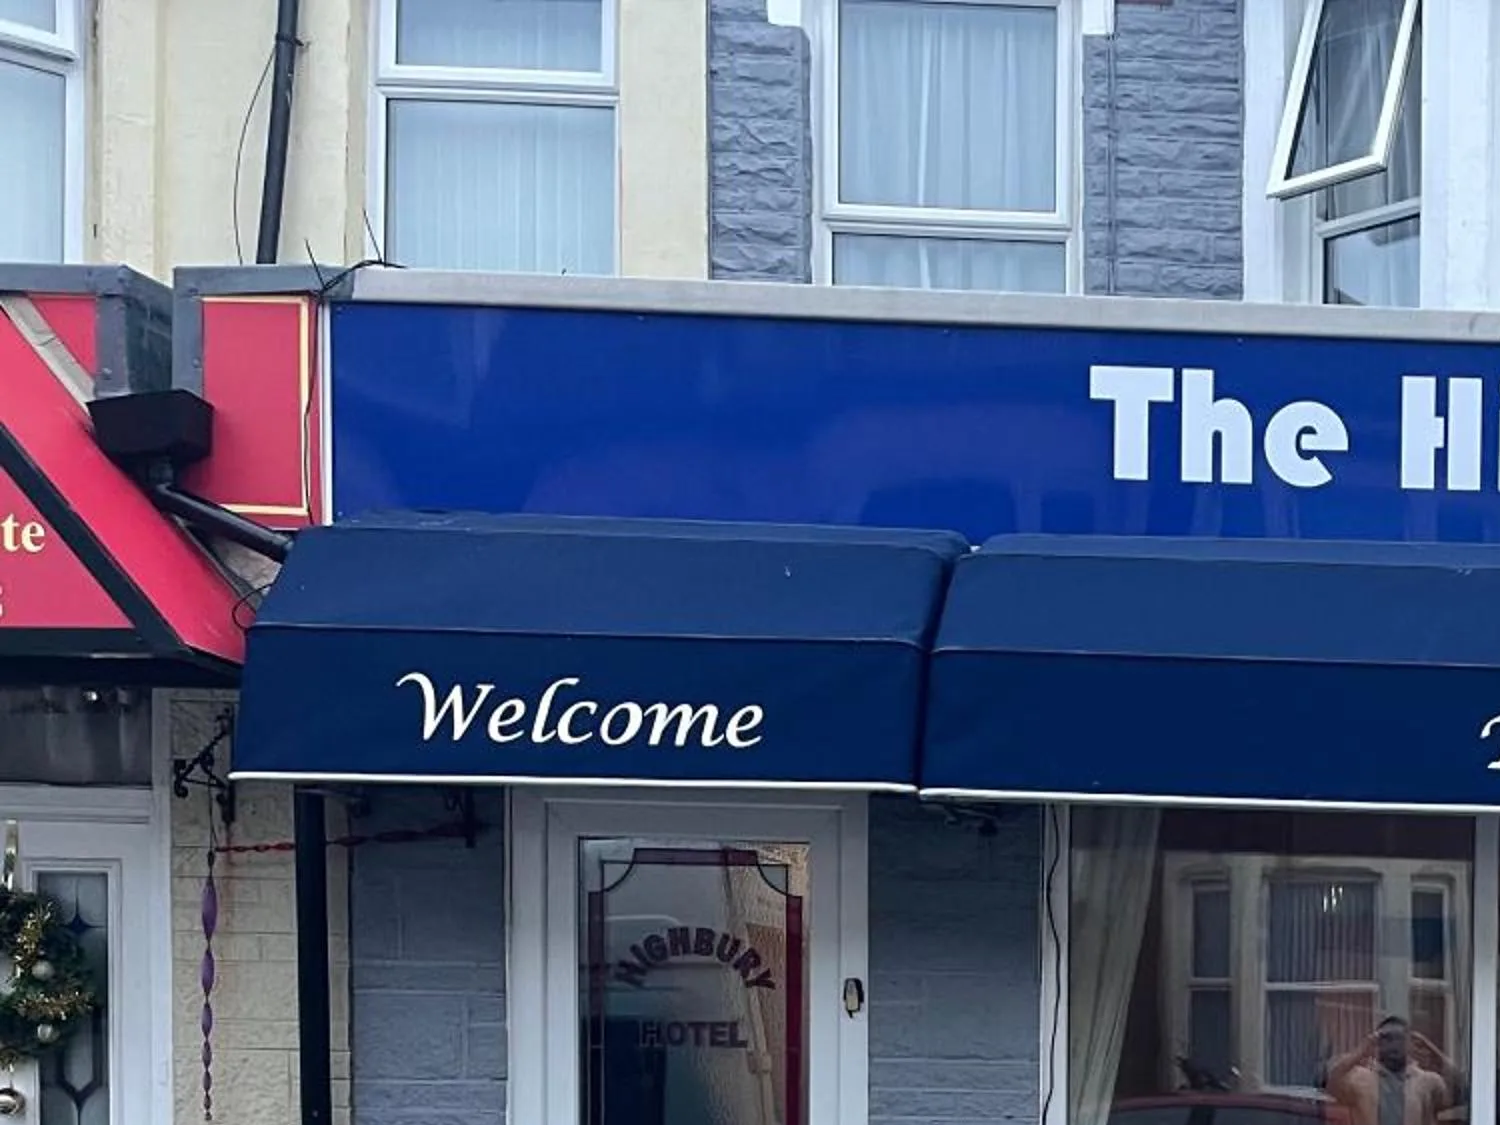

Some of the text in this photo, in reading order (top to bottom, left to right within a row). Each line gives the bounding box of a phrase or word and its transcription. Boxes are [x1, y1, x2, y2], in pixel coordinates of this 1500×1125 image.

[1089, 364, 1349, 488] The
[395, 671, 764, 749] Welcome
[614, 926, 776, 990] HIGHBURY
[638, 1020, 748, 1049] HOTEL
